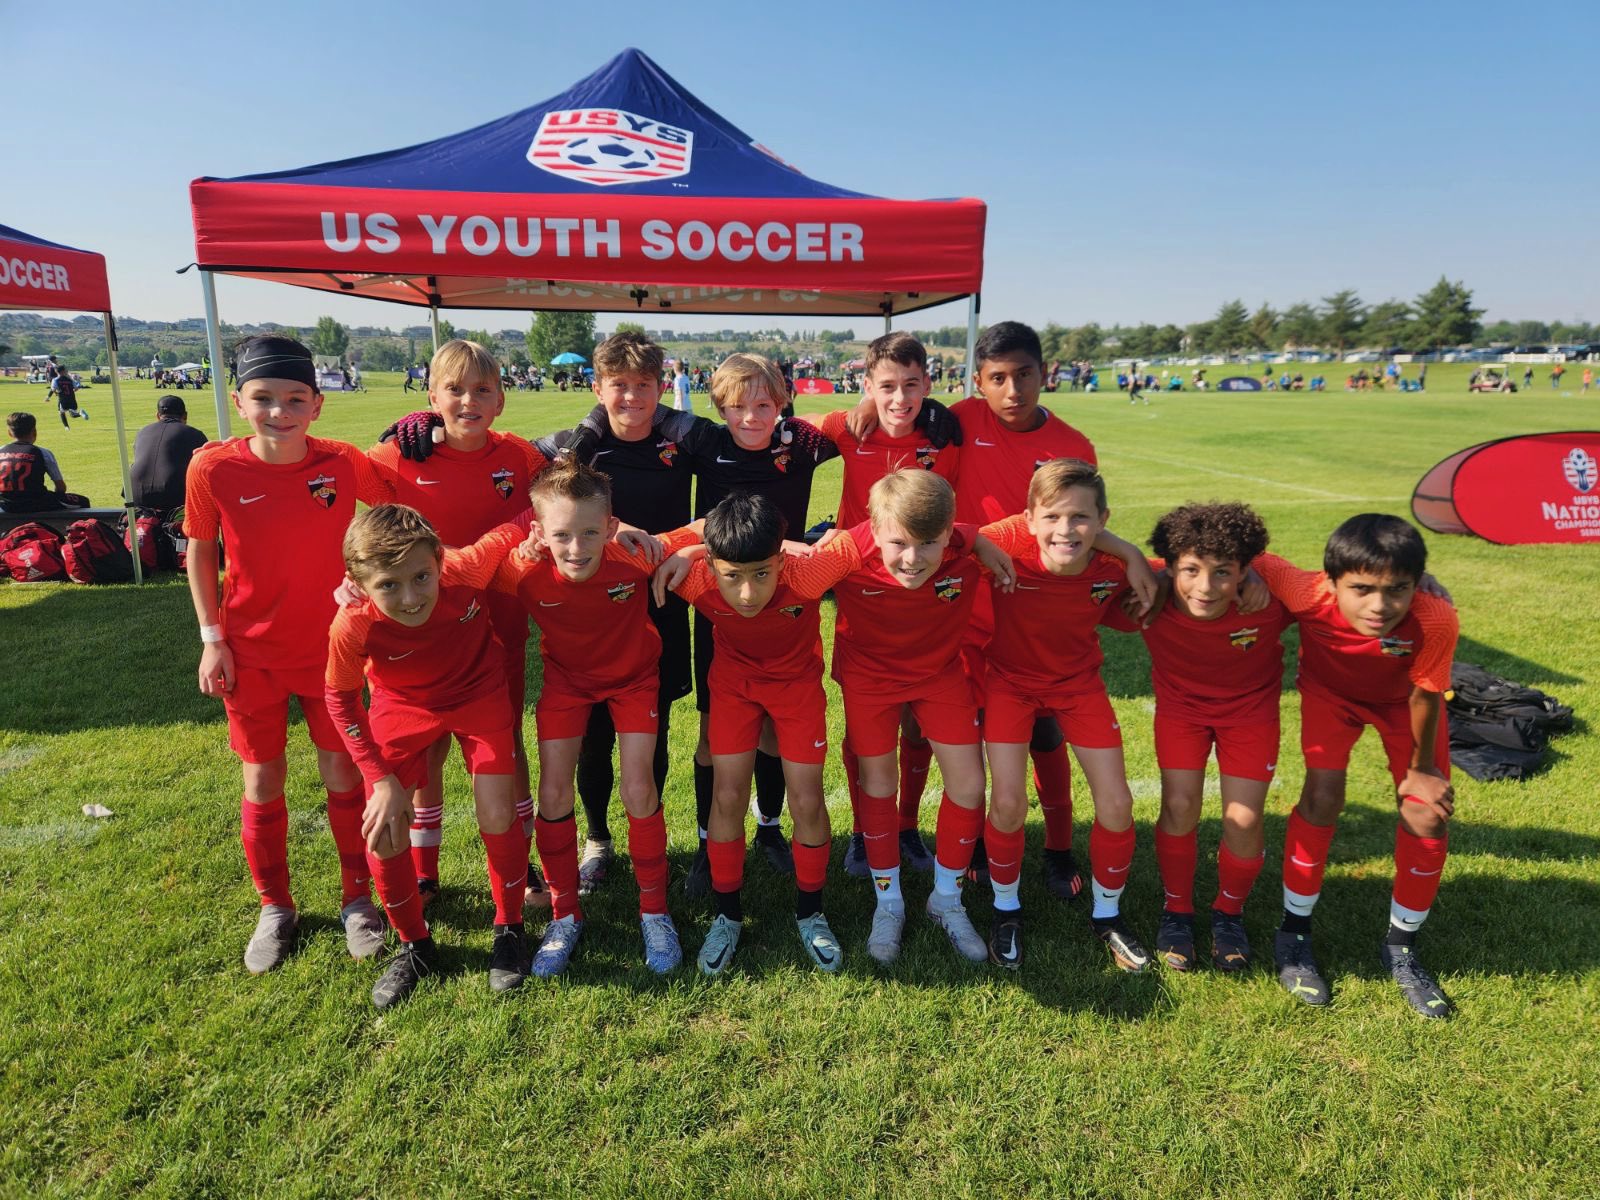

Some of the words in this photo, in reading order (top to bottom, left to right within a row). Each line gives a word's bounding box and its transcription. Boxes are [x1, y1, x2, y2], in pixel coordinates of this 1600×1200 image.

[547, 110, 688, 144] USYS
[320, 211, 401, 254] US
[417, 213, 621, 258] YOUTH
[640, 219, 865, 262] SOCCER
[0, 461, 32, 491] 27
[1542, 501, 1600, 520] NATIO
[1580, 528, 1600, 537] SERI
